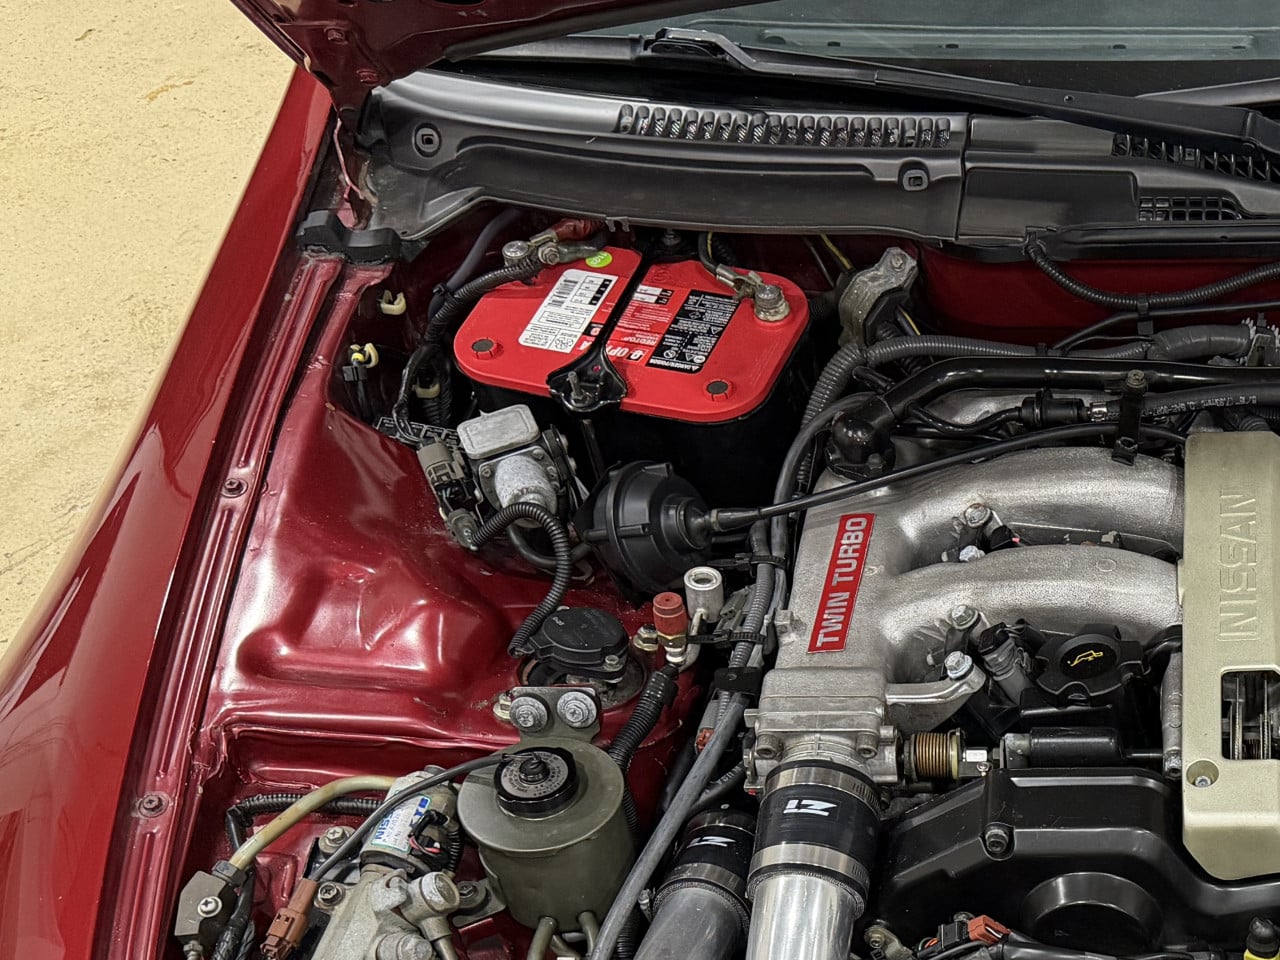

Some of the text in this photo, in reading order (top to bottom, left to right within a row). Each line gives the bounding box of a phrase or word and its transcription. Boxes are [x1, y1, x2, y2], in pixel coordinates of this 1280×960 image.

[816, 517, 867, 647] TWIN TURBO
[1219, 488, 1257, 641] NISSAN
